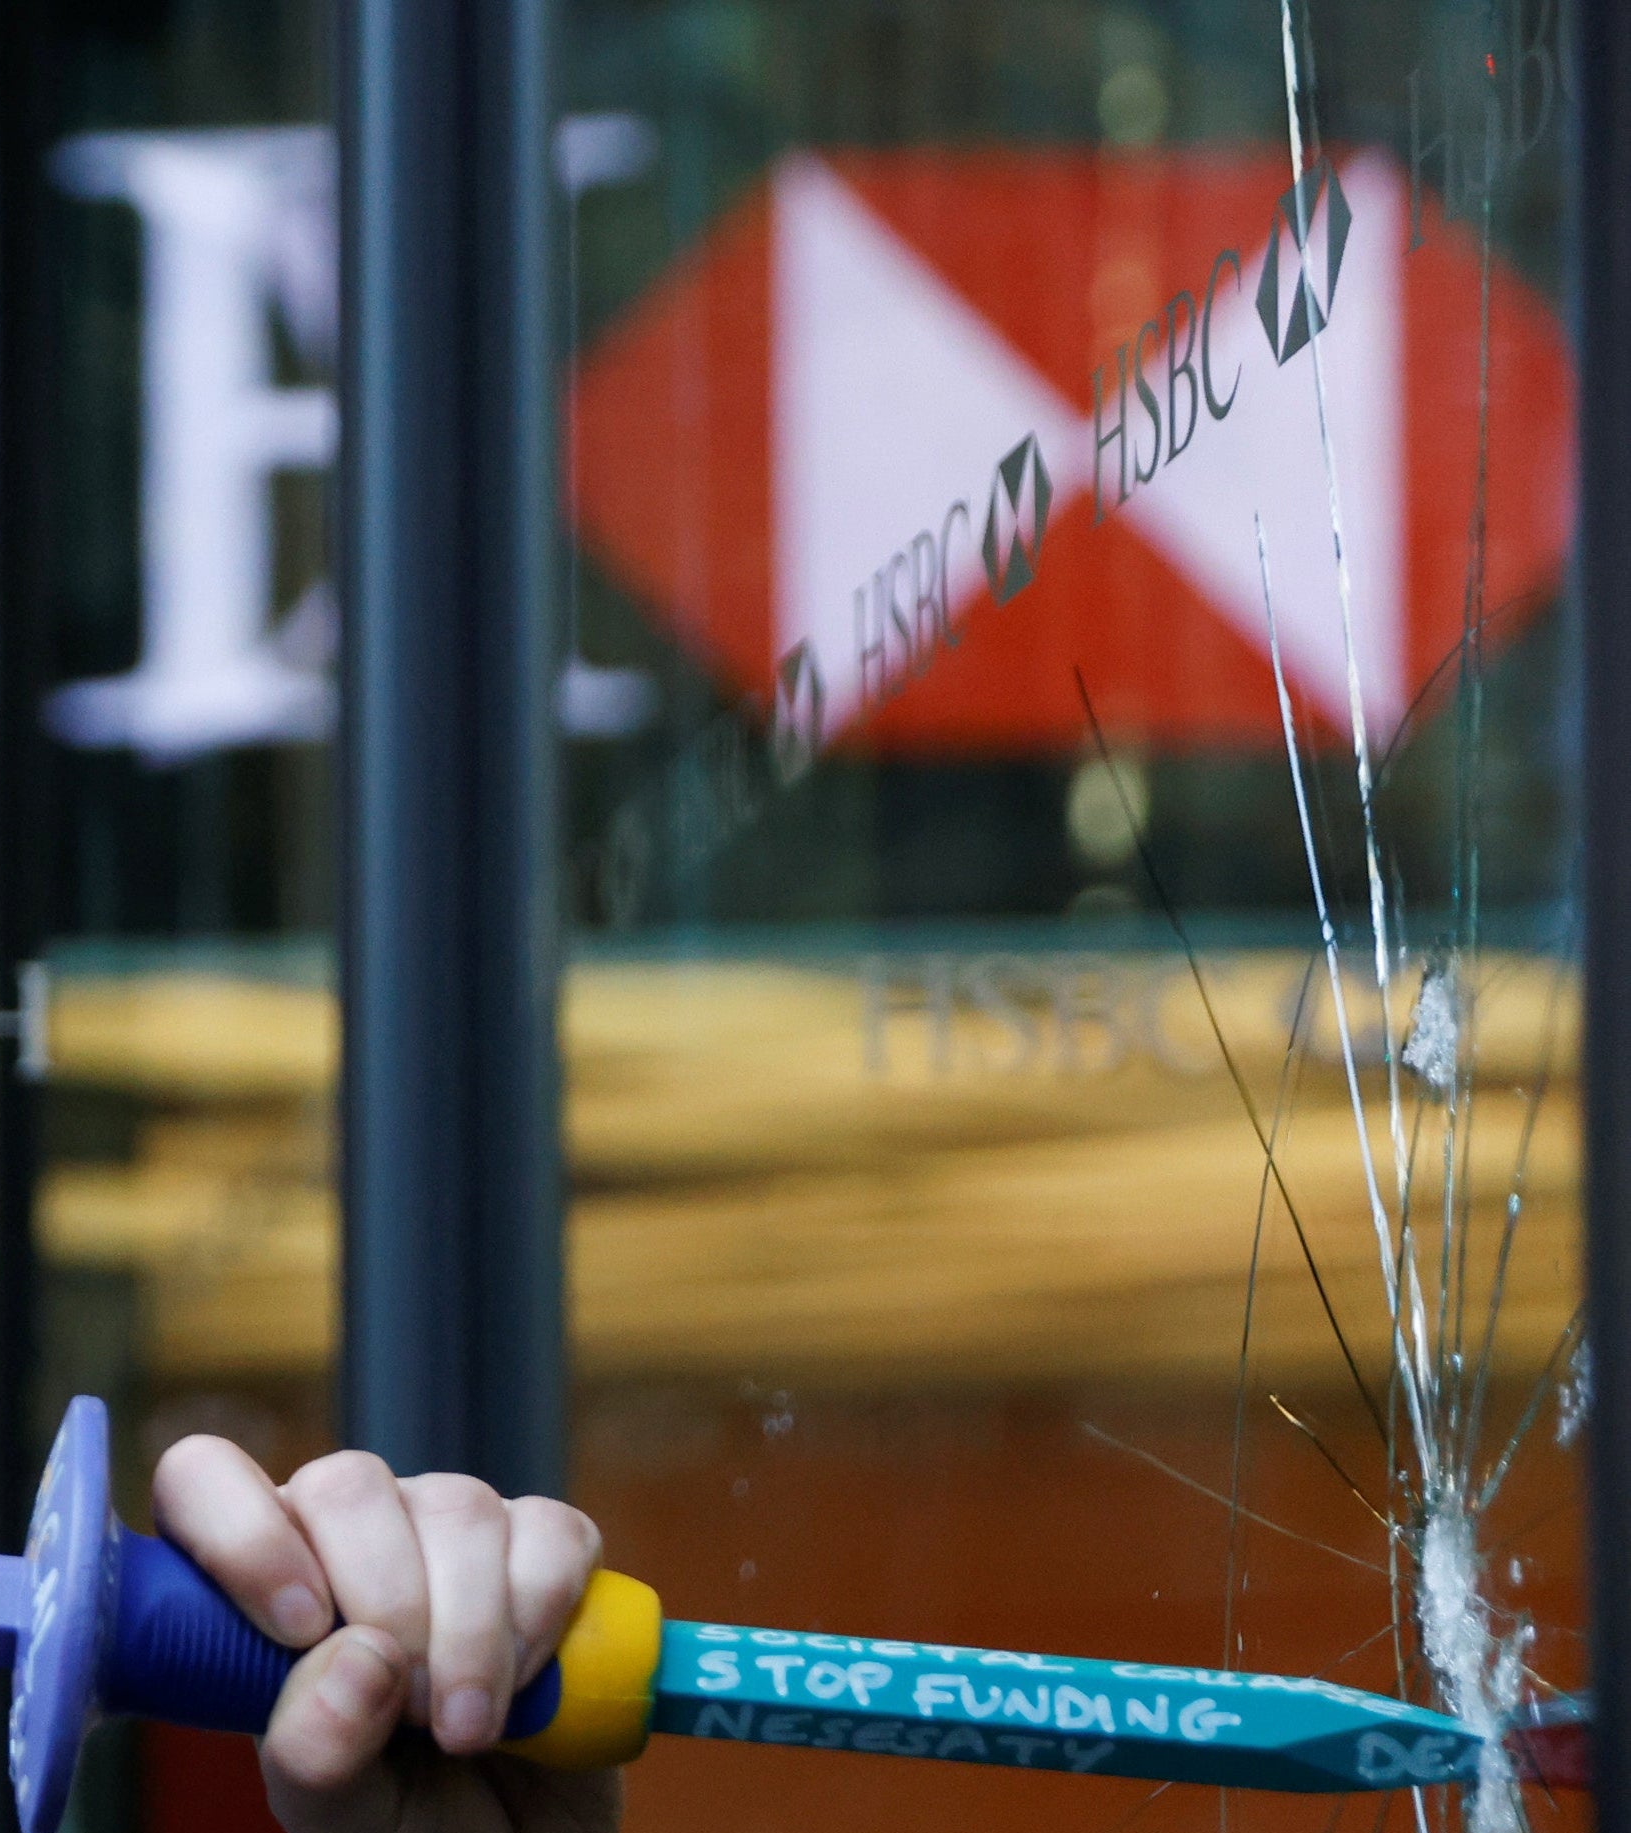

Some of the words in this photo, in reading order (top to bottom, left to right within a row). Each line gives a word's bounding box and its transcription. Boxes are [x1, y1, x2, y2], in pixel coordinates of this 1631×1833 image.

[1089, 248, 1243, 530] HSBC
[851, 498, 971, 710] HSBC
[694, 1623, 1074, 1674] SOCIETAL
[695, 1649, 893, 1707] STOP
[911, 1673, 1243, 1742] FUNDING
